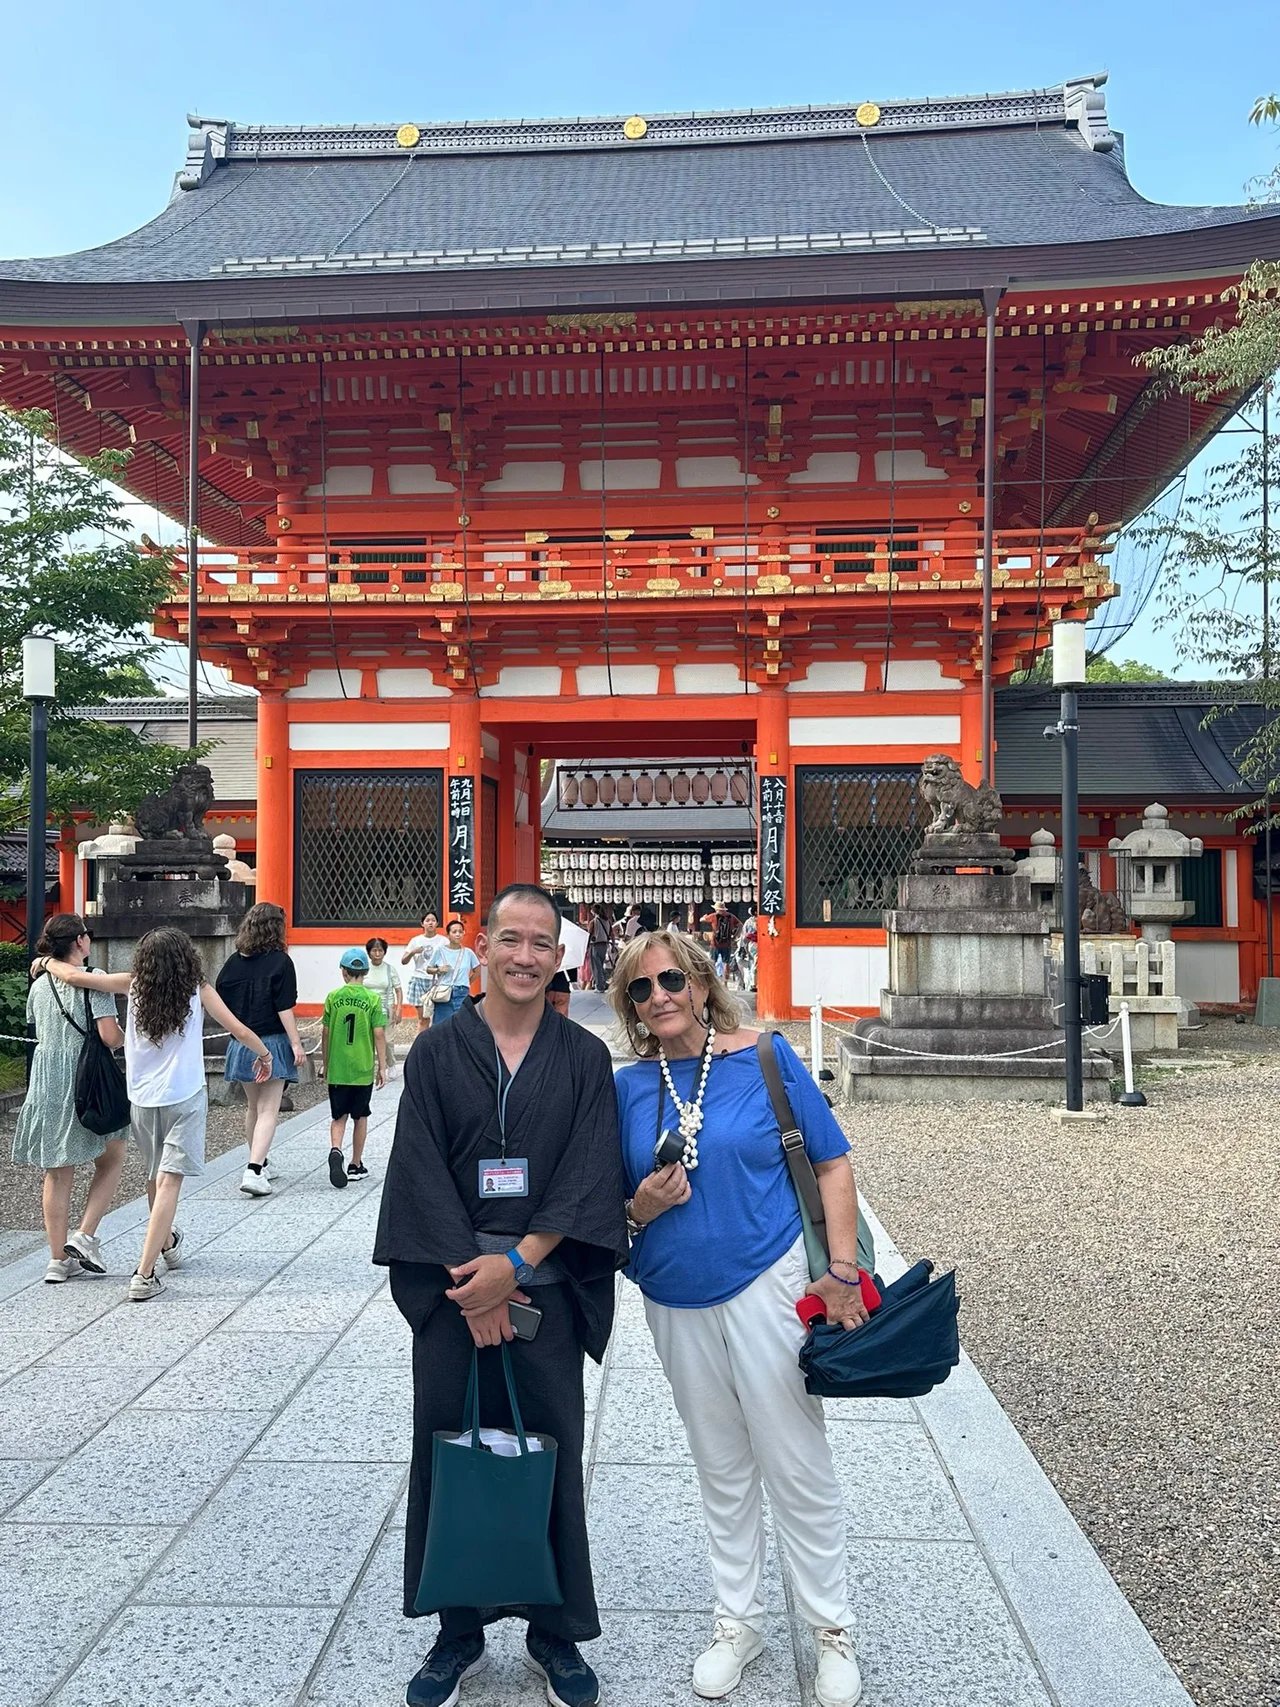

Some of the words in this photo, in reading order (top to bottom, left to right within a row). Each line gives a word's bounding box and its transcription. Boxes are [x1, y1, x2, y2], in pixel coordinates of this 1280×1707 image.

[449, 778, 461, 819] 午前十時
[460, 778, 473, 816] 九月一日
[762, 778, 773, 824] 午前十時
[450, 824, 474, 905] 月次祭
[762, 826, 783, 914] 月次祭
[333, 998, 345, 1010] TER
[345, 997, 370, 1013] STEGEN
[343, 1013, 356, 1046] 1
